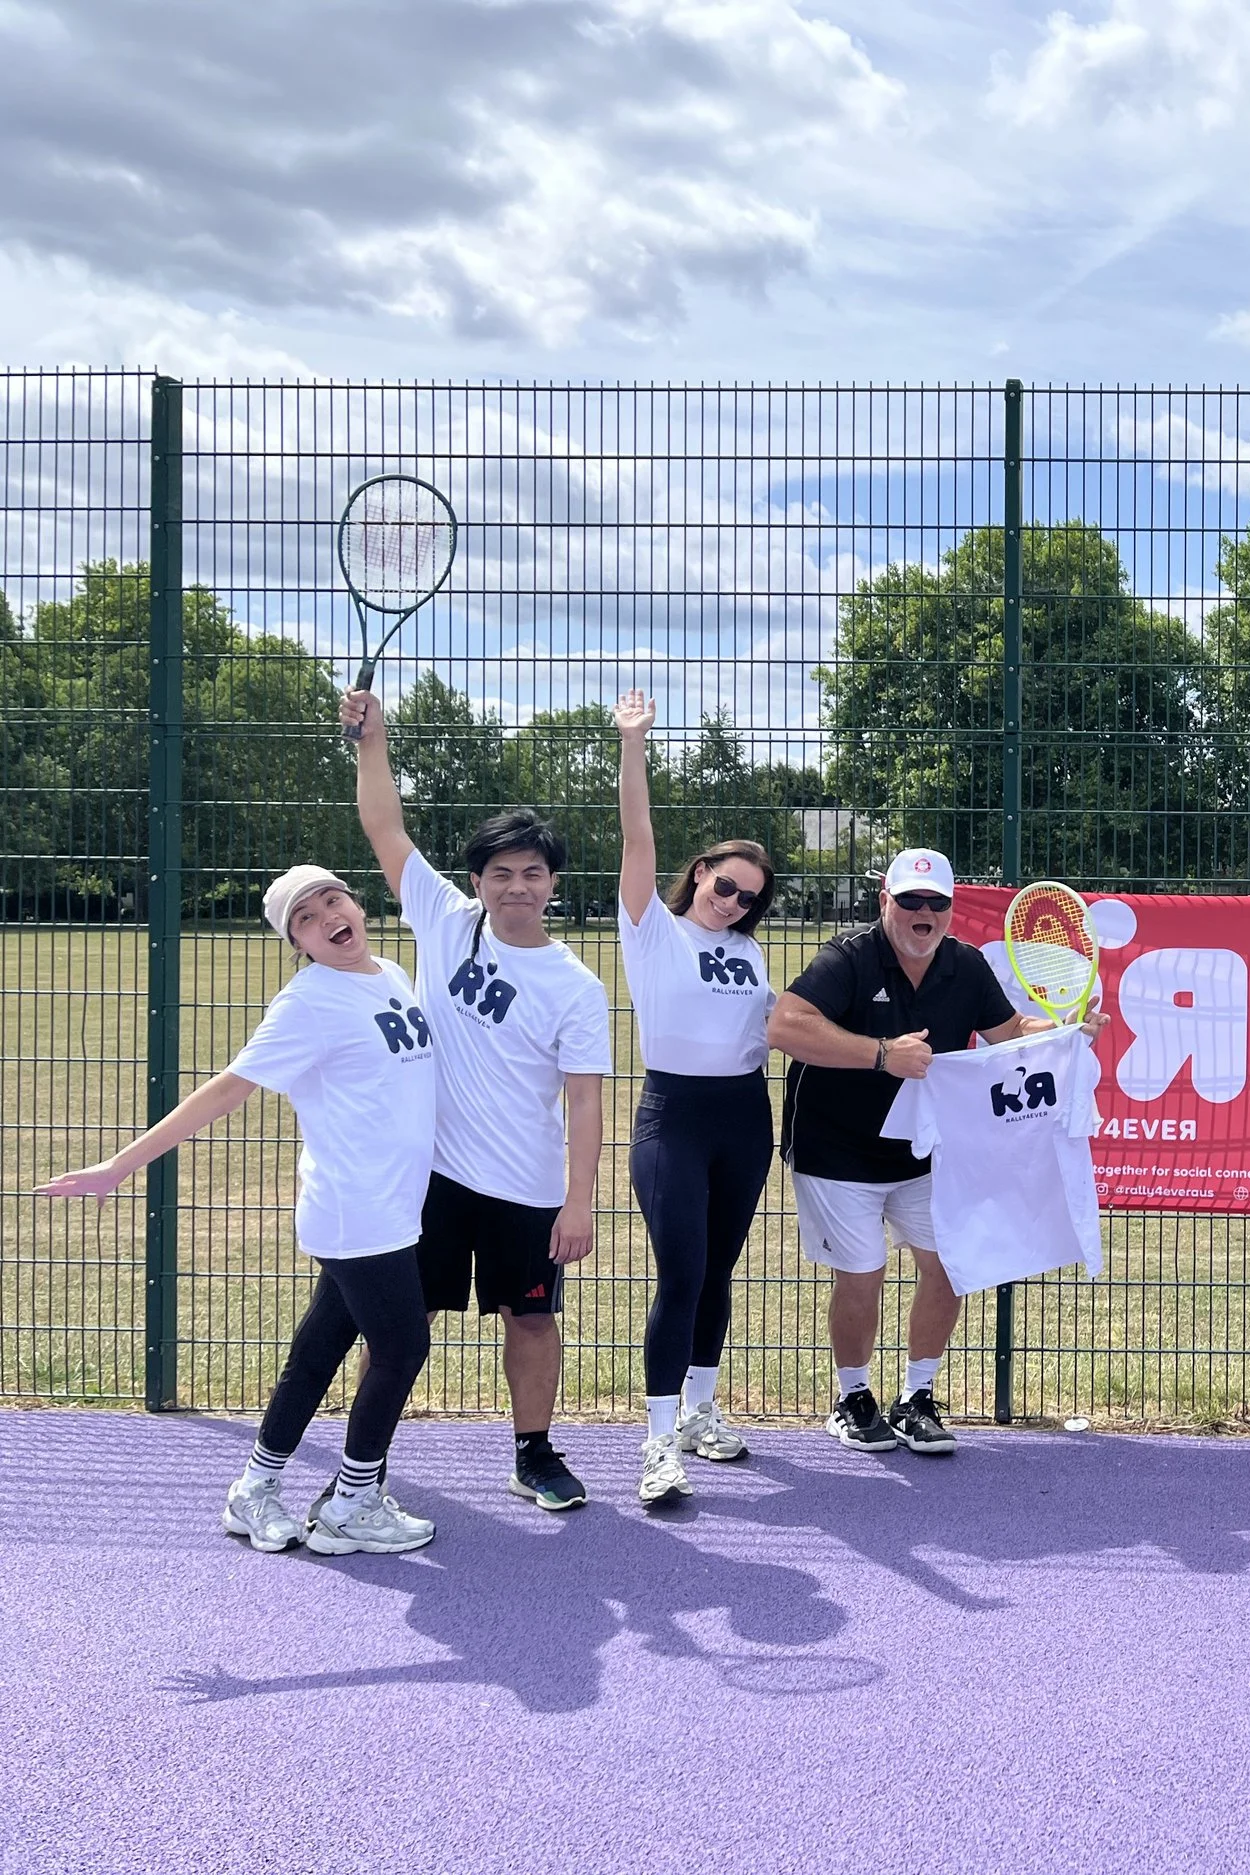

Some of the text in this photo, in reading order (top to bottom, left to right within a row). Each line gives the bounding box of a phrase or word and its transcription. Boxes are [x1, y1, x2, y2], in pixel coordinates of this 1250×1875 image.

[1093, 1164, 1149, 1178] together
[1151, 1165, 1170, 1177] for
[1173, 1166, 1213, 1178] social
[1115, 1185, 1215, 1199] @rally4everaus
